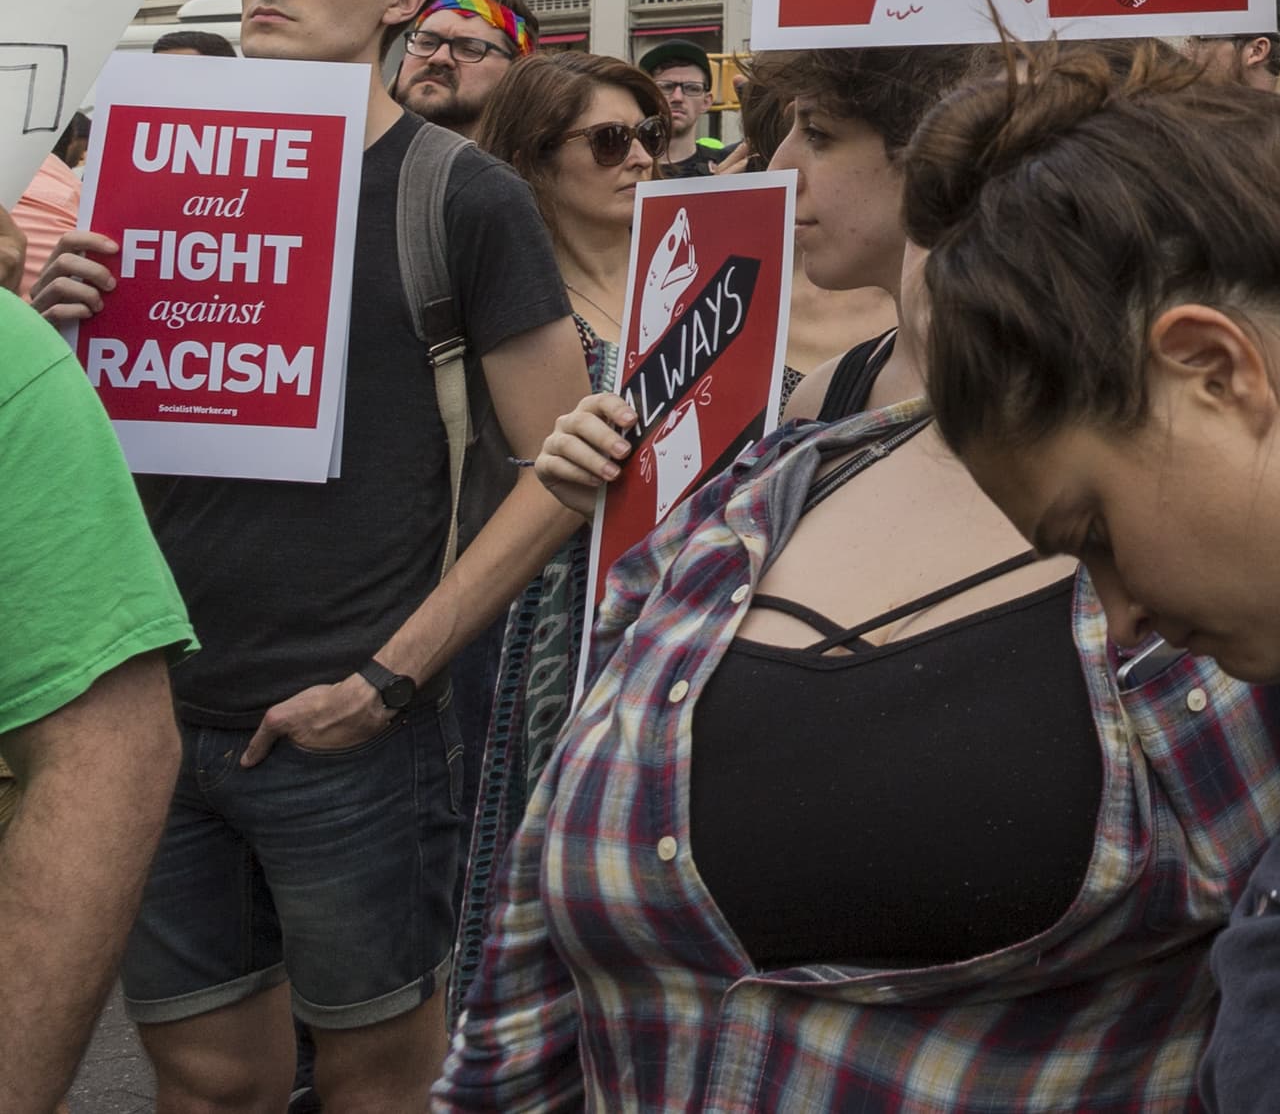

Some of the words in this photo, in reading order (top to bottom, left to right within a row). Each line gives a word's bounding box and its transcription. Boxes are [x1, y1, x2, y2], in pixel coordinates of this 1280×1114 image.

[132, 122, 313, 179] UNITE
[182, 189, 249, 217] and
[120, 229, 303, 285] FIGHT
[149, 294, 266, 329] against
[87, 337, 315, 396] RACISM
[620, 266, 743, 438] ALWAYS
[159, 404, 238, 417] SocialistWorker.org
